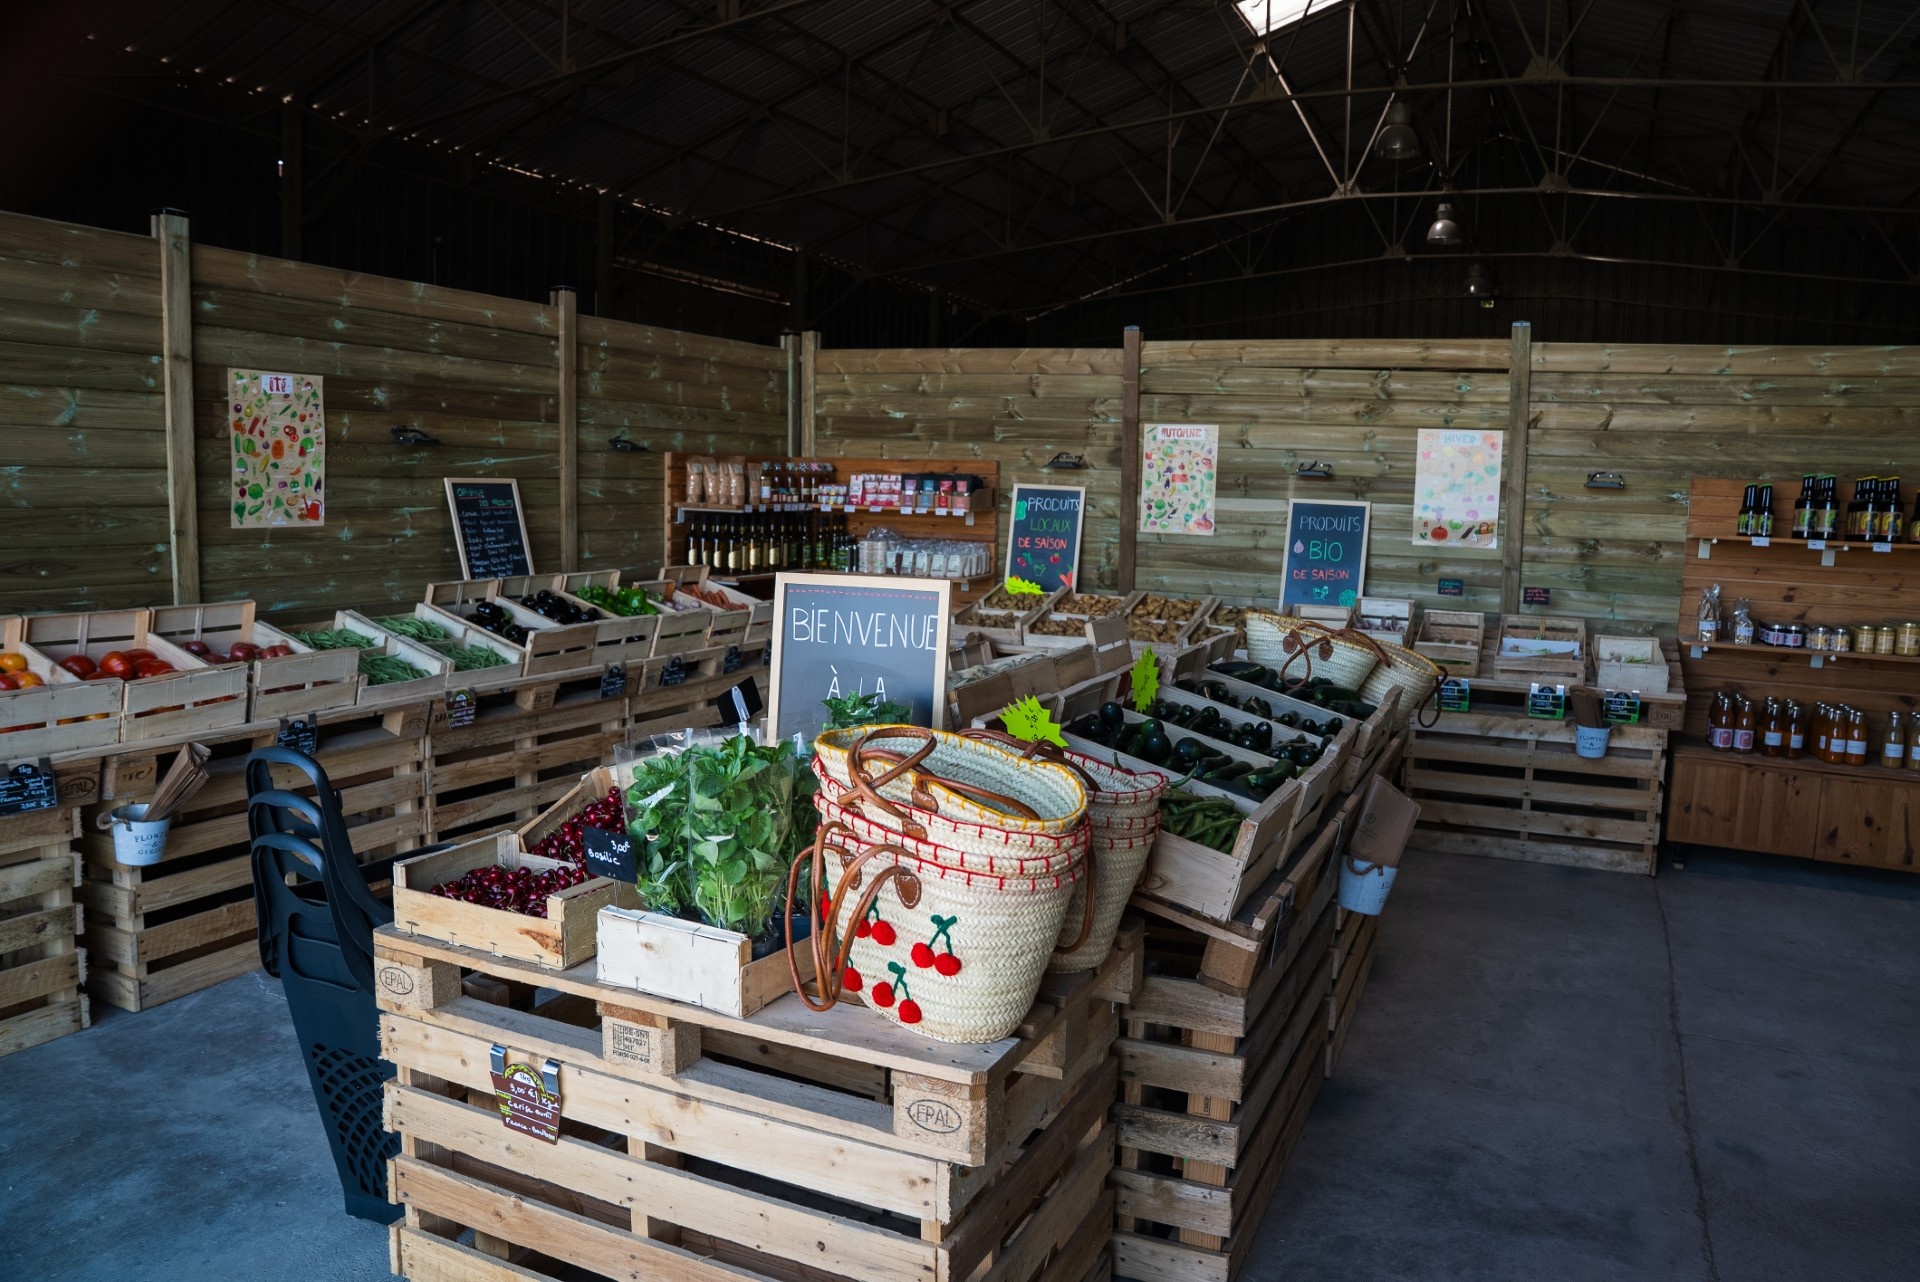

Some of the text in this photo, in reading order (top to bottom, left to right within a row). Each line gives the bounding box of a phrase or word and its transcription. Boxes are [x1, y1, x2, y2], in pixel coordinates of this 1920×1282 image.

[1161, 427, 1202, 438] AUTOMNE
[1444, 433, 1476, 444] HIVER
[1030, 518, 1071, 532] LOCAUX
[1017, 537, 1031, 548] DE
[1293, 569, 1350, 581] DE SAISON
[826, 665, 842, 699] À
[18, 766, 33, 775] 1kg
[610, 839, 631, 854] 3,00€
[587, 848, 621, 866] Basilic
[384, 970, 409, 990] EPAL
[917, 1104, 955, 1129] EPAL
